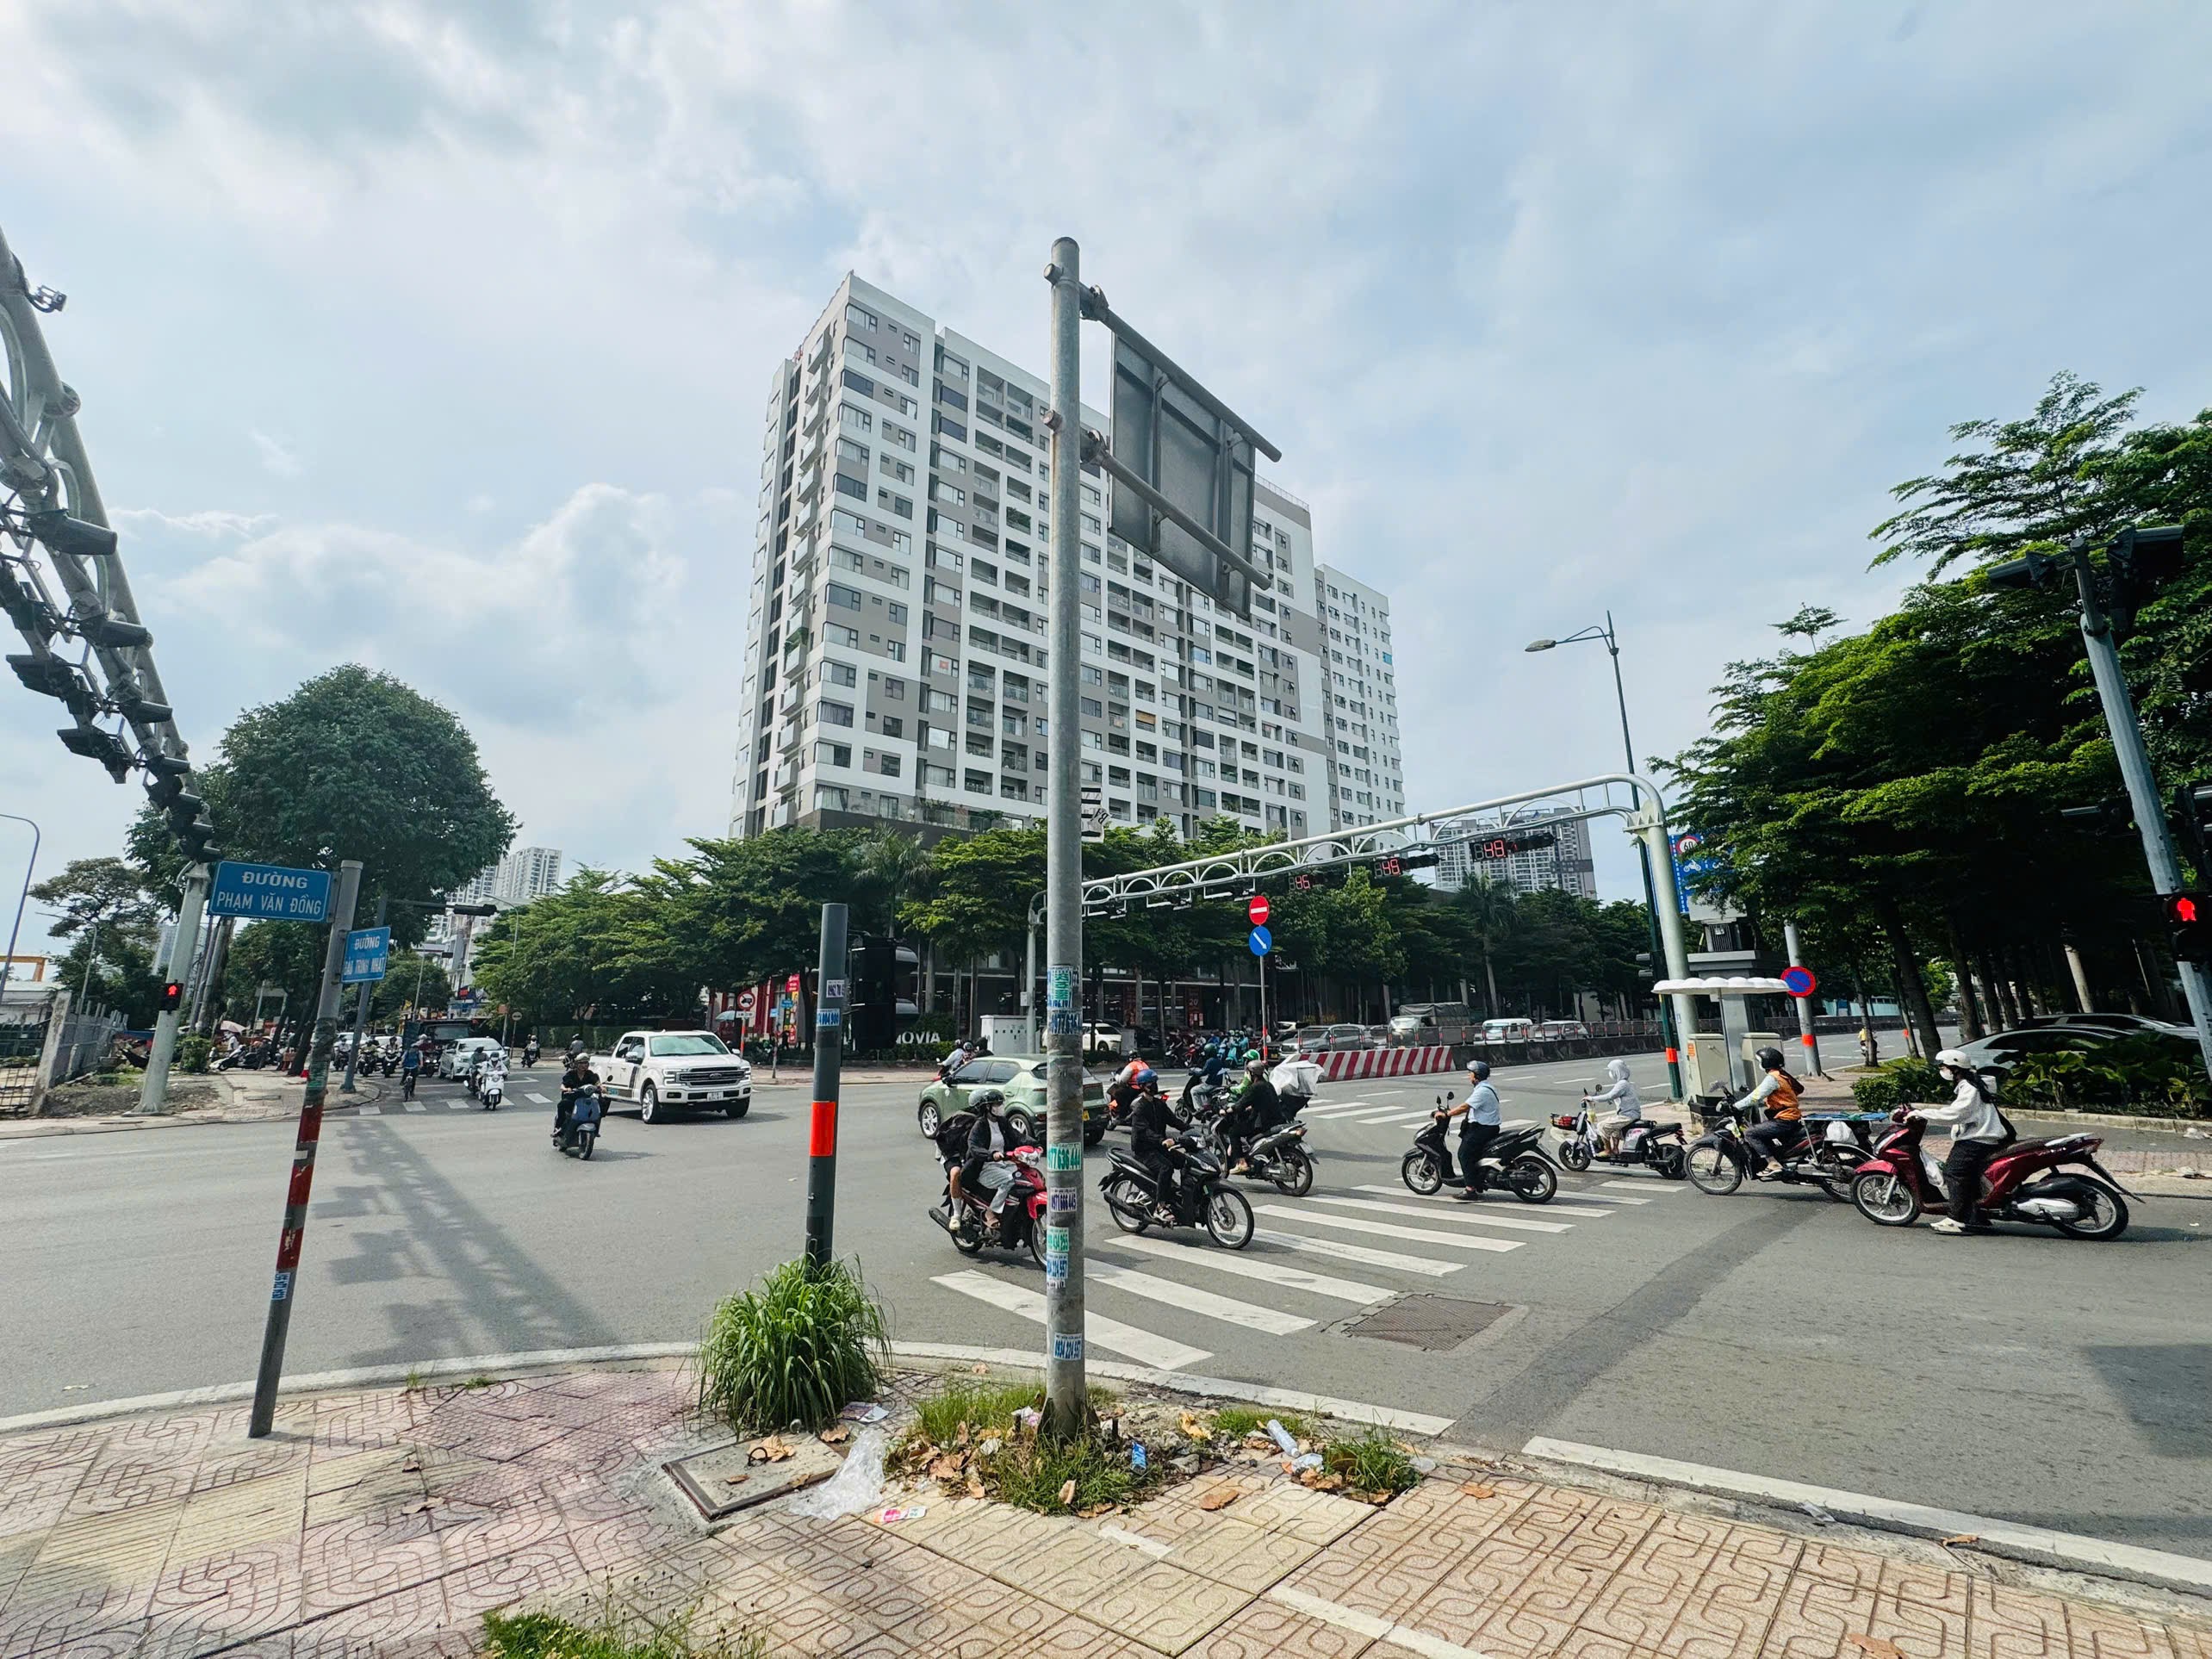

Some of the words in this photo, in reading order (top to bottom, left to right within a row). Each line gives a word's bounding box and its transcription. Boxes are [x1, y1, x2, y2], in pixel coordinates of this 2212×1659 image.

[241, 871, 308, 889] ĐƯỜNG
[216, 891, 254, 911] PHẠM
[261, 892, 284, 912] VĂN
[289, 893, 322, 915] ĐỒNG
